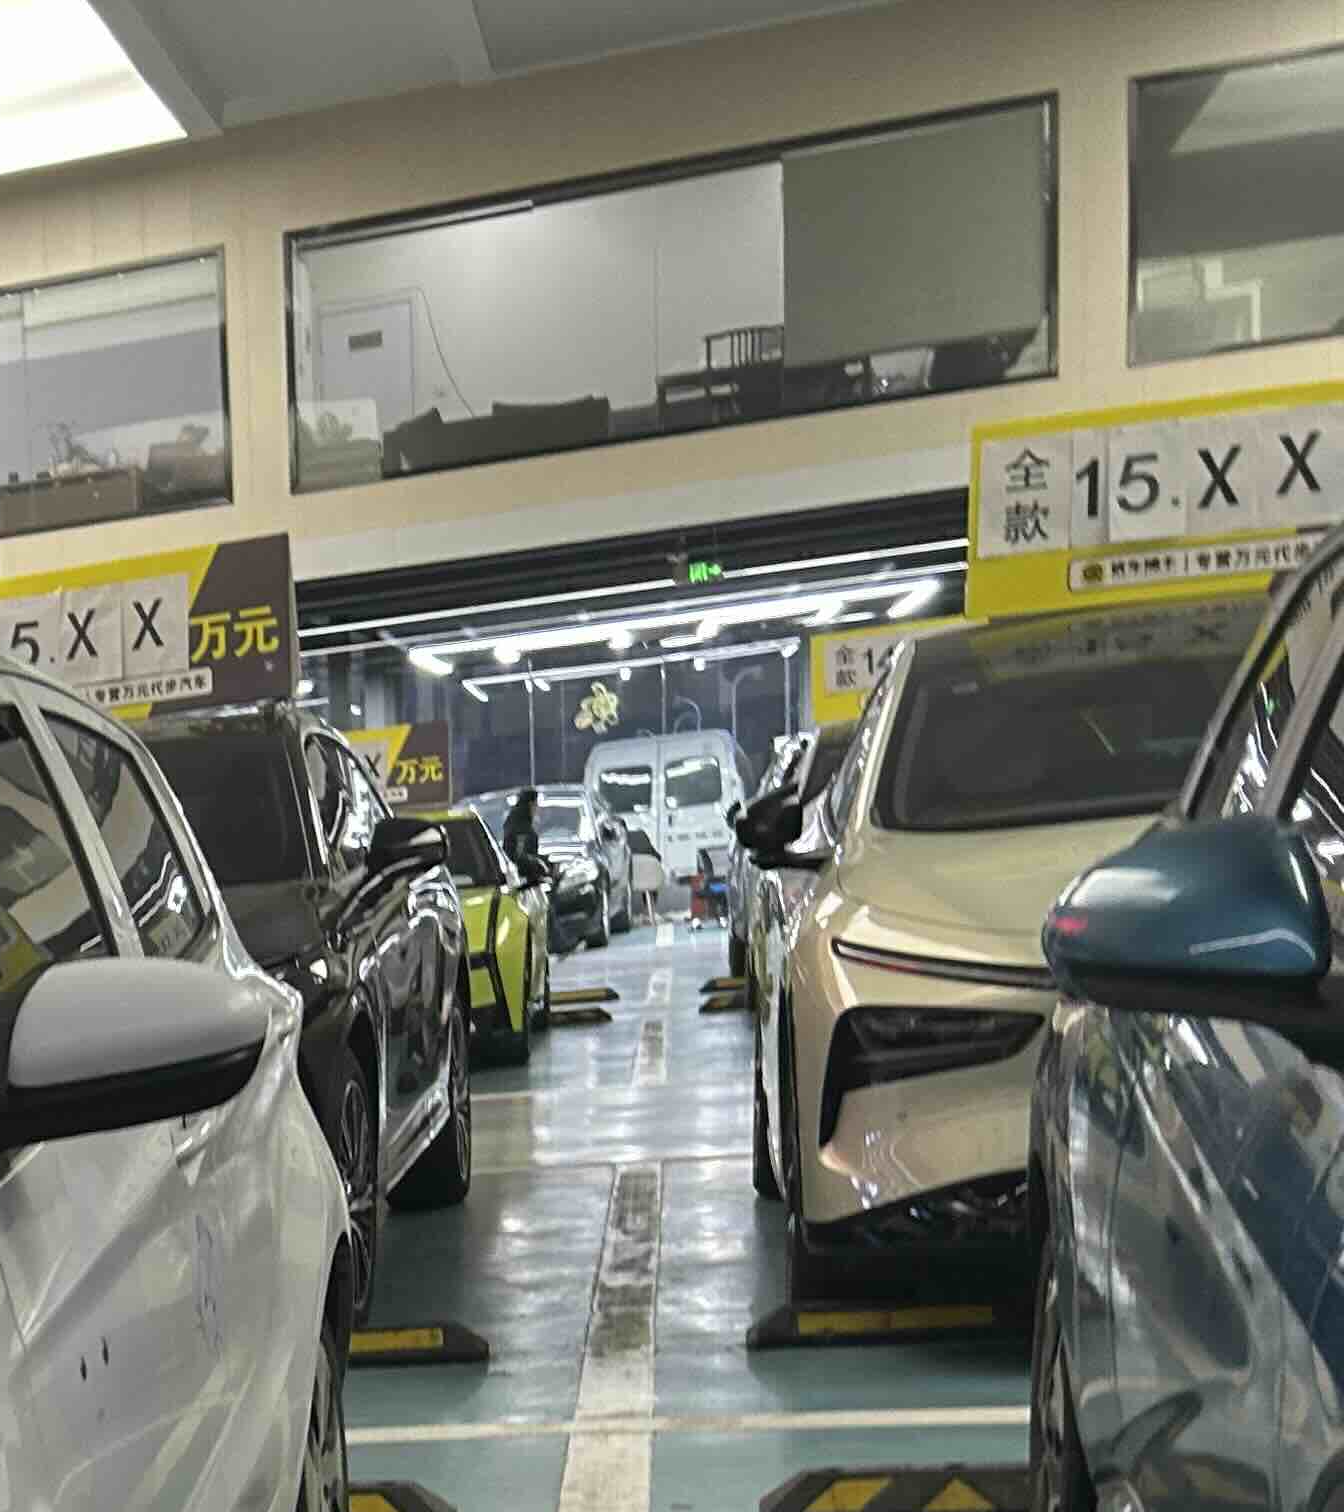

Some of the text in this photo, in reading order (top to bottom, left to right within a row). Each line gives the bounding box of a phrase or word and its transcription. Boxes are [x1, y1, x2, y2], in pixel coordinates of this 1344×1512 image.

[1004, 448, 1050, 544] 全款
[188, 605, 280, 663] 万元
[396, 755, 444, 785] 万元
